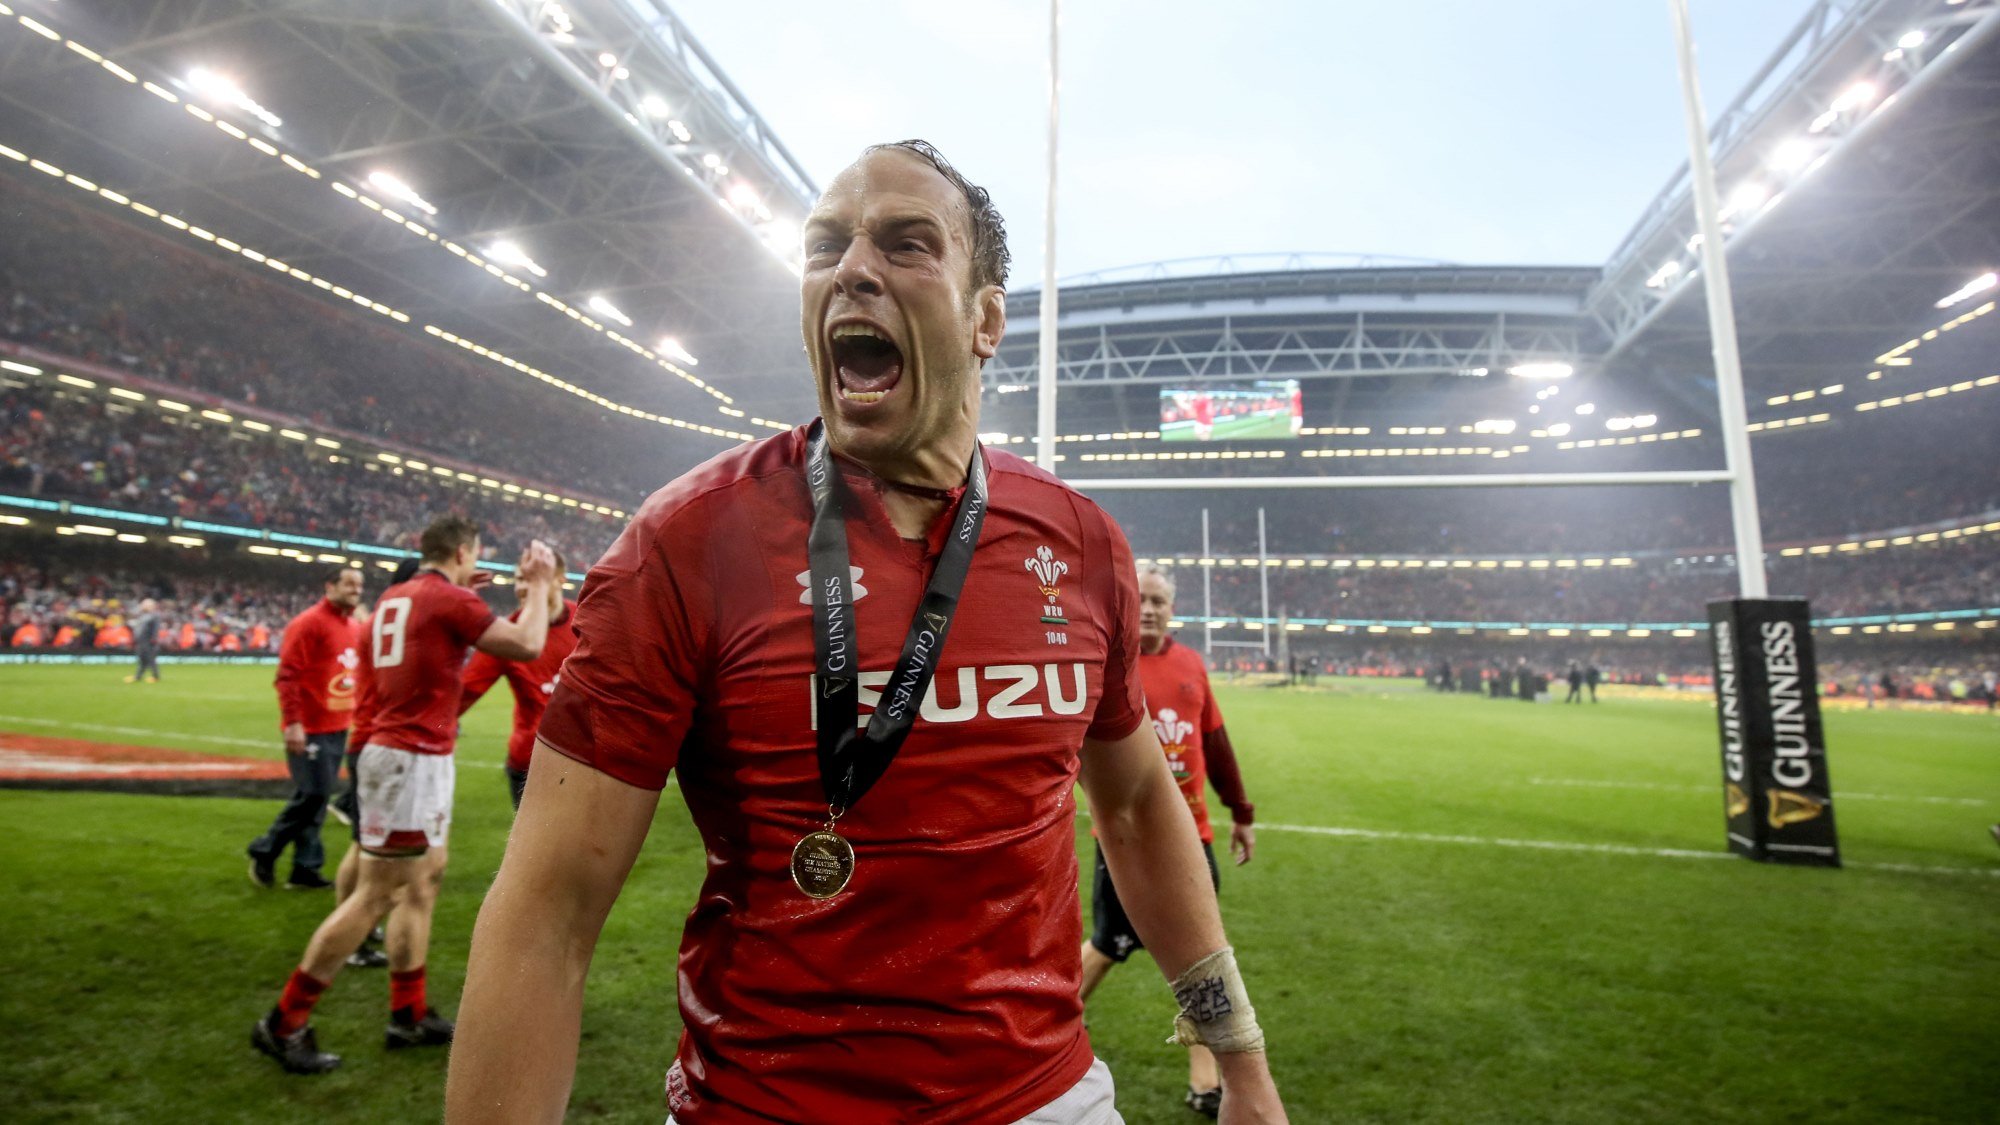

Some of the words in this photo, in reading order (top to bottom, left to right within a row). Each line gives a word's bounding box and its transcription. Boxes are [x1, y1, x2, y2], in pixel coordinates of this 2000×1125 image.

[960, 468, 984, 544] GUINNESS
[372, 597, 412, 669] 8
[825, 576, 847, 672] GUINNESS
[1043, 605, 1063, 617] WRU
[1045, 631, 1068, 645] 1046
[887, 630, 936, 721] GUINNESS
[1714, 620, 1745, 782] GUINNESS
[1760, 620, 1813, 788] GUINNESS
